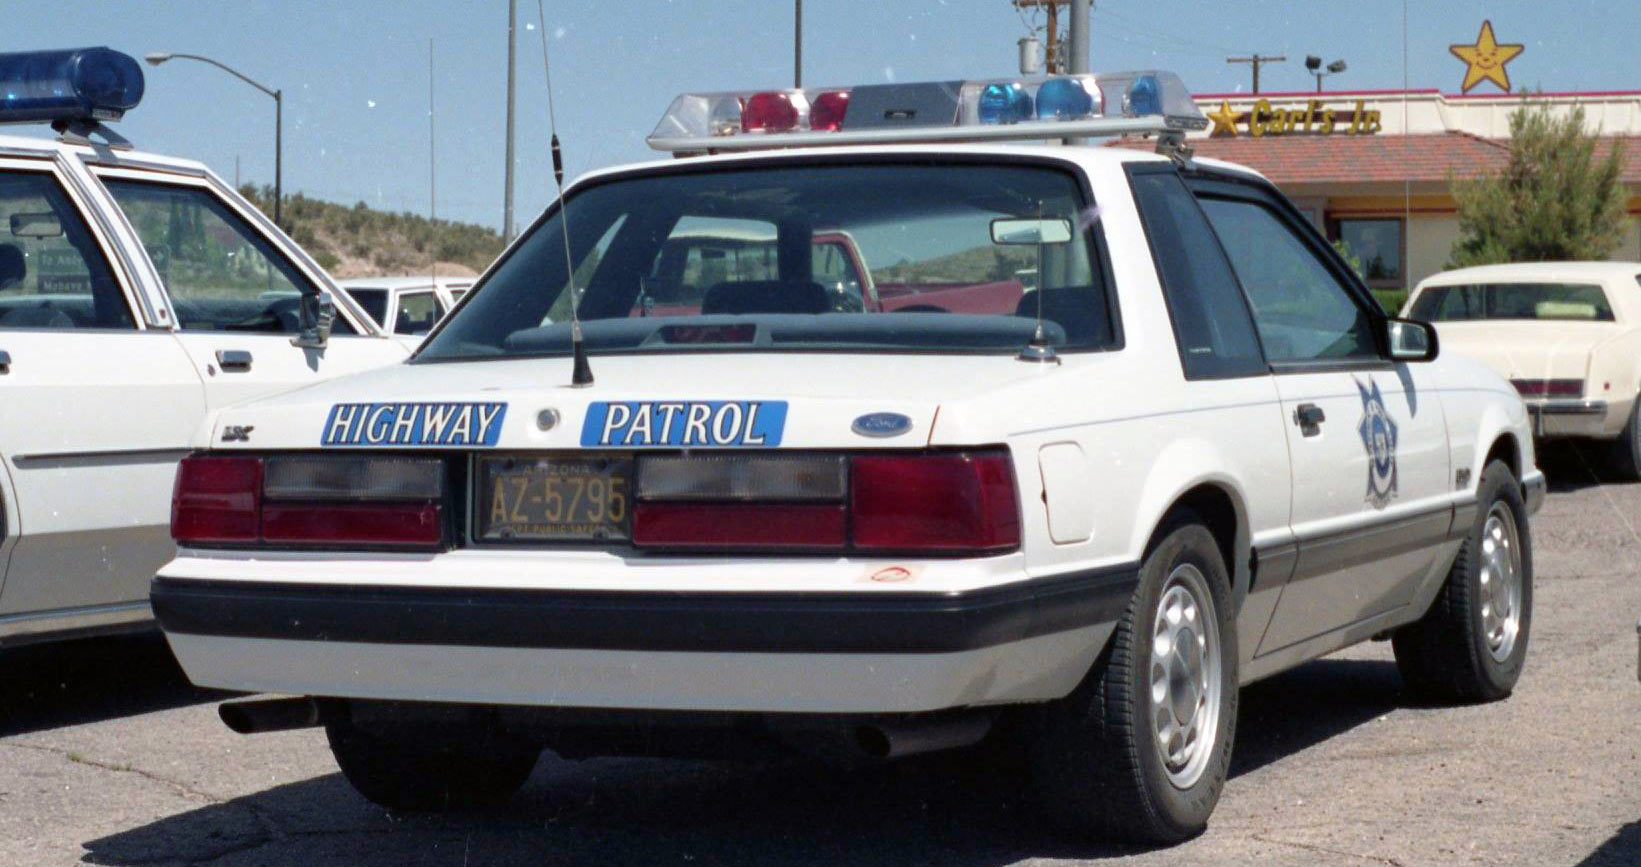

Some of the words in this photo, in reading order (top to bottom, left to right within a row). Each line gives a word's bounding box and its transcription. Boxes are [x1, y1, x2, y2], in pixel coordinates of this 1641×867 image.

[1249, 97, 1336, 136] Carl's
[221, 424, 255, 441] LX
[325, 403, 503, 445] HIGHWAY
[598, 401, 768, 446] PATROL
[491, 475, 626, 524] AZ-5795
